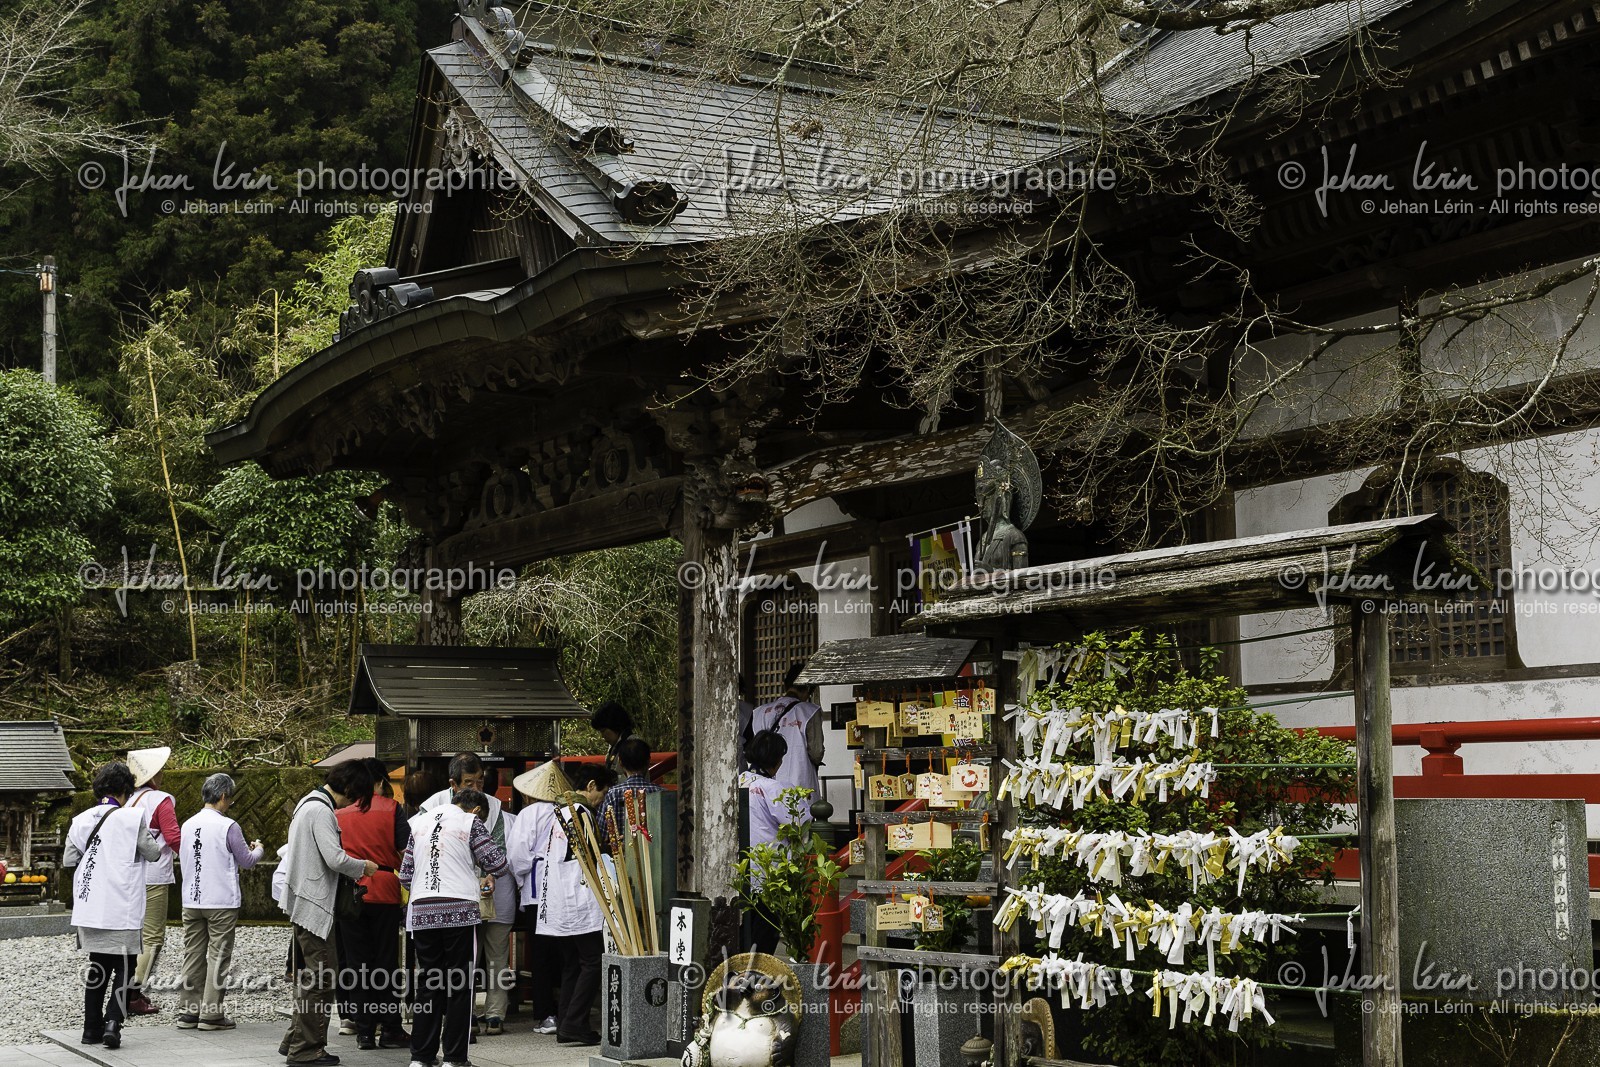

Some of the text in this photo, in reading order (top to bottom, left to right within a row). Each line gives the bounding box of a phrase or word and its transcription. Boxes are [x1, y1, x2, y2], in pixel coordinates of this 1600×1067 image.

[676, 911, 687, 962] 本堂
[609, 969, 620, 1042] 岩本寺
